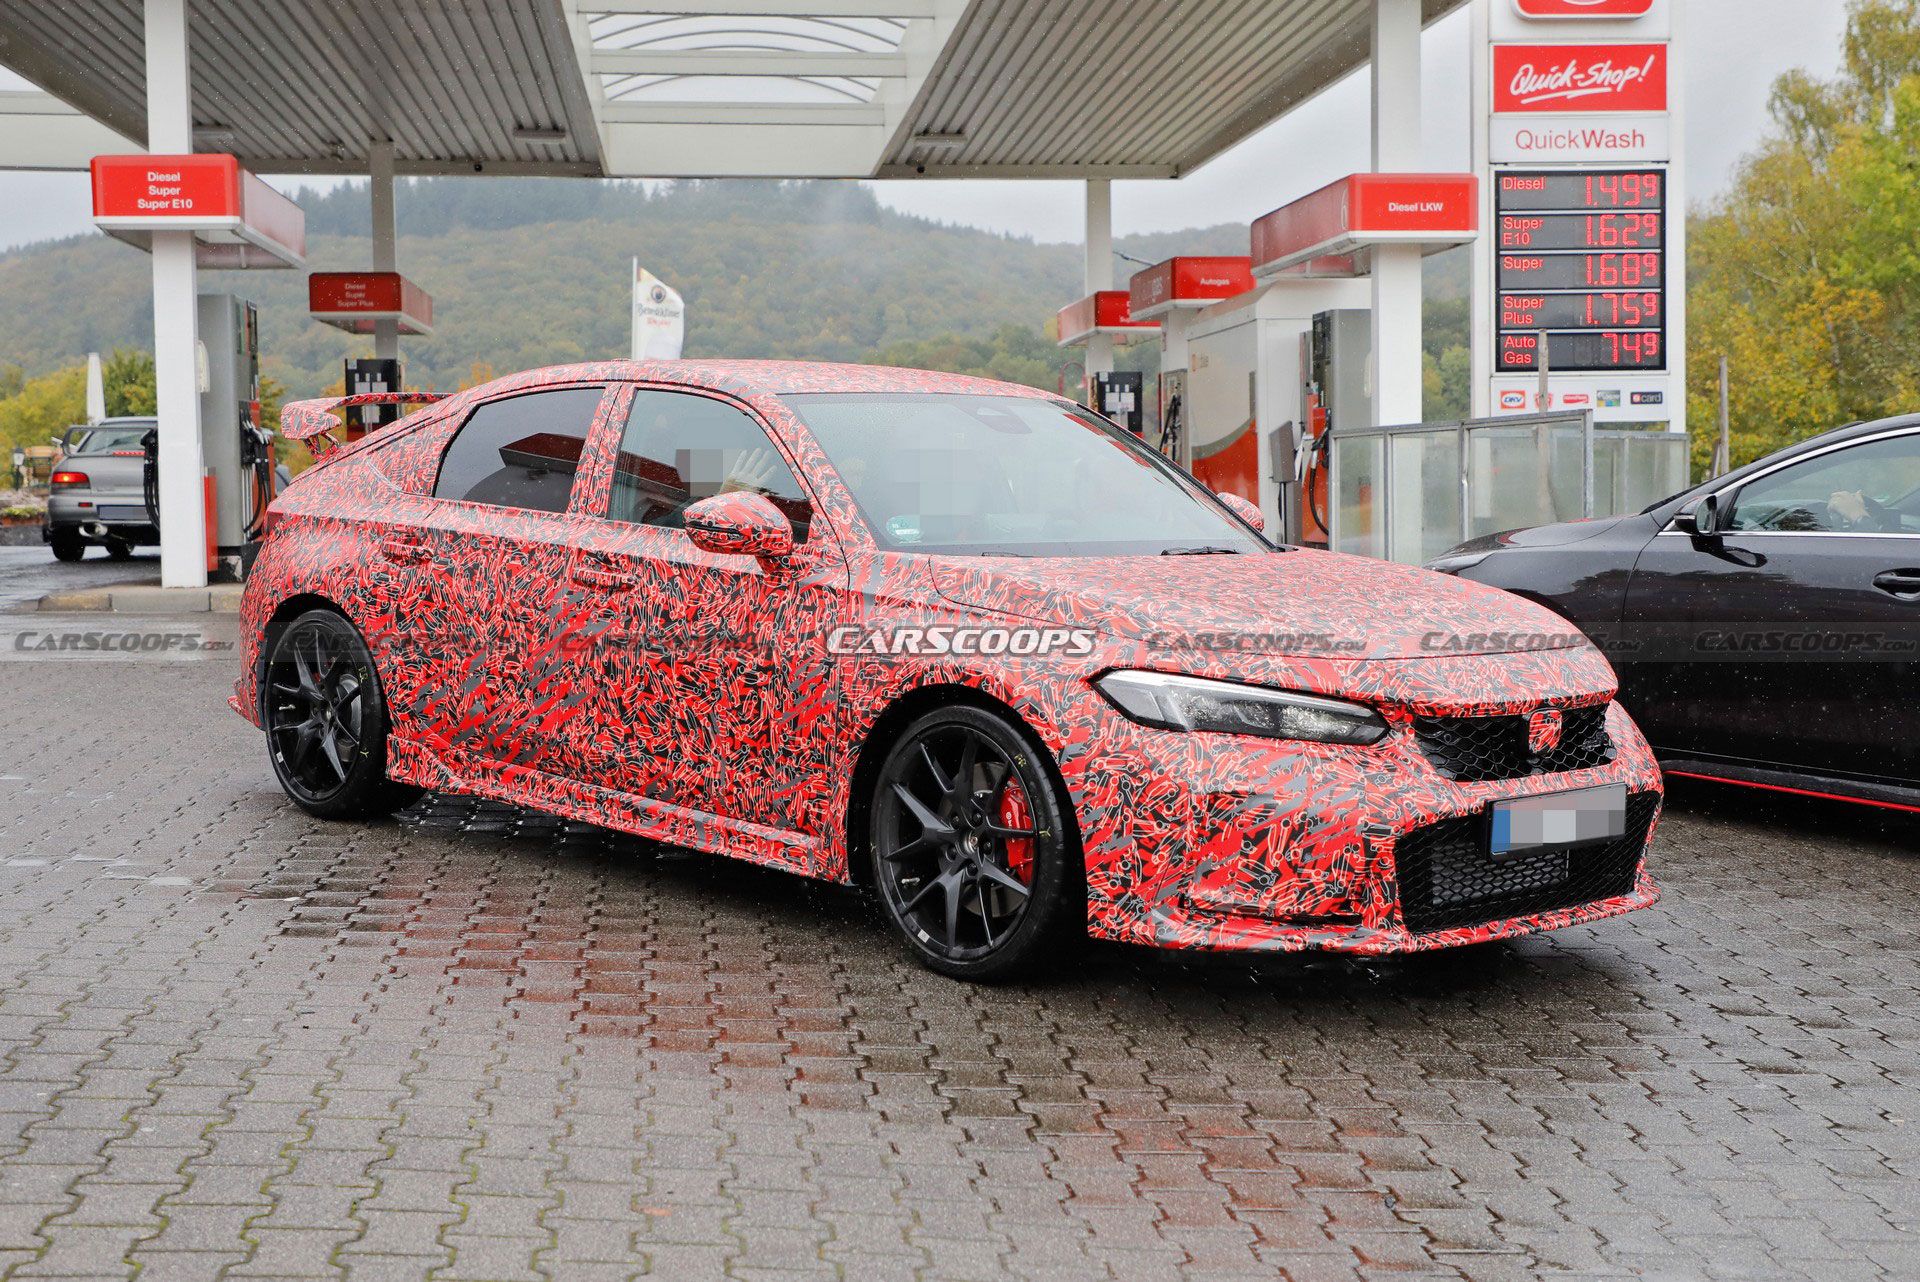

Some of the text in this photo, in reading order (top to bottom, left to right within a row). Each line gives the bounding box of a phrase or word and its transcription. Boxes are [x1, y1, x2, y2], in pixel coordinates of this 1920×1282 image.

[1510, 54, 1655, 96] Quick-Shop!
[1515, 129, 1645, 150] QuickWash
[147, 172, 181, 182] Diesel
[1502, 176, 1545, 190] Diesel
[148, 185, 181, 197] Super
[137, 198, 193, 210] Super E10
[1388, 201, 1444, 212] Diesel LKW
[1503, 217, 1544, 233] Super
[1503, 233, 1531, 245] E10
[1503, 256, 1544, 272] Super
[1199, 277, 1230, 288] Autogas
[337, 300, 358, 308] Super
[1503, 296, 1545, 311] Super
[1503, 312, 1534, 325] Plus
[1504, 335, 1537, 348] Auto
[1504, 352, 1533, 364] Gas
